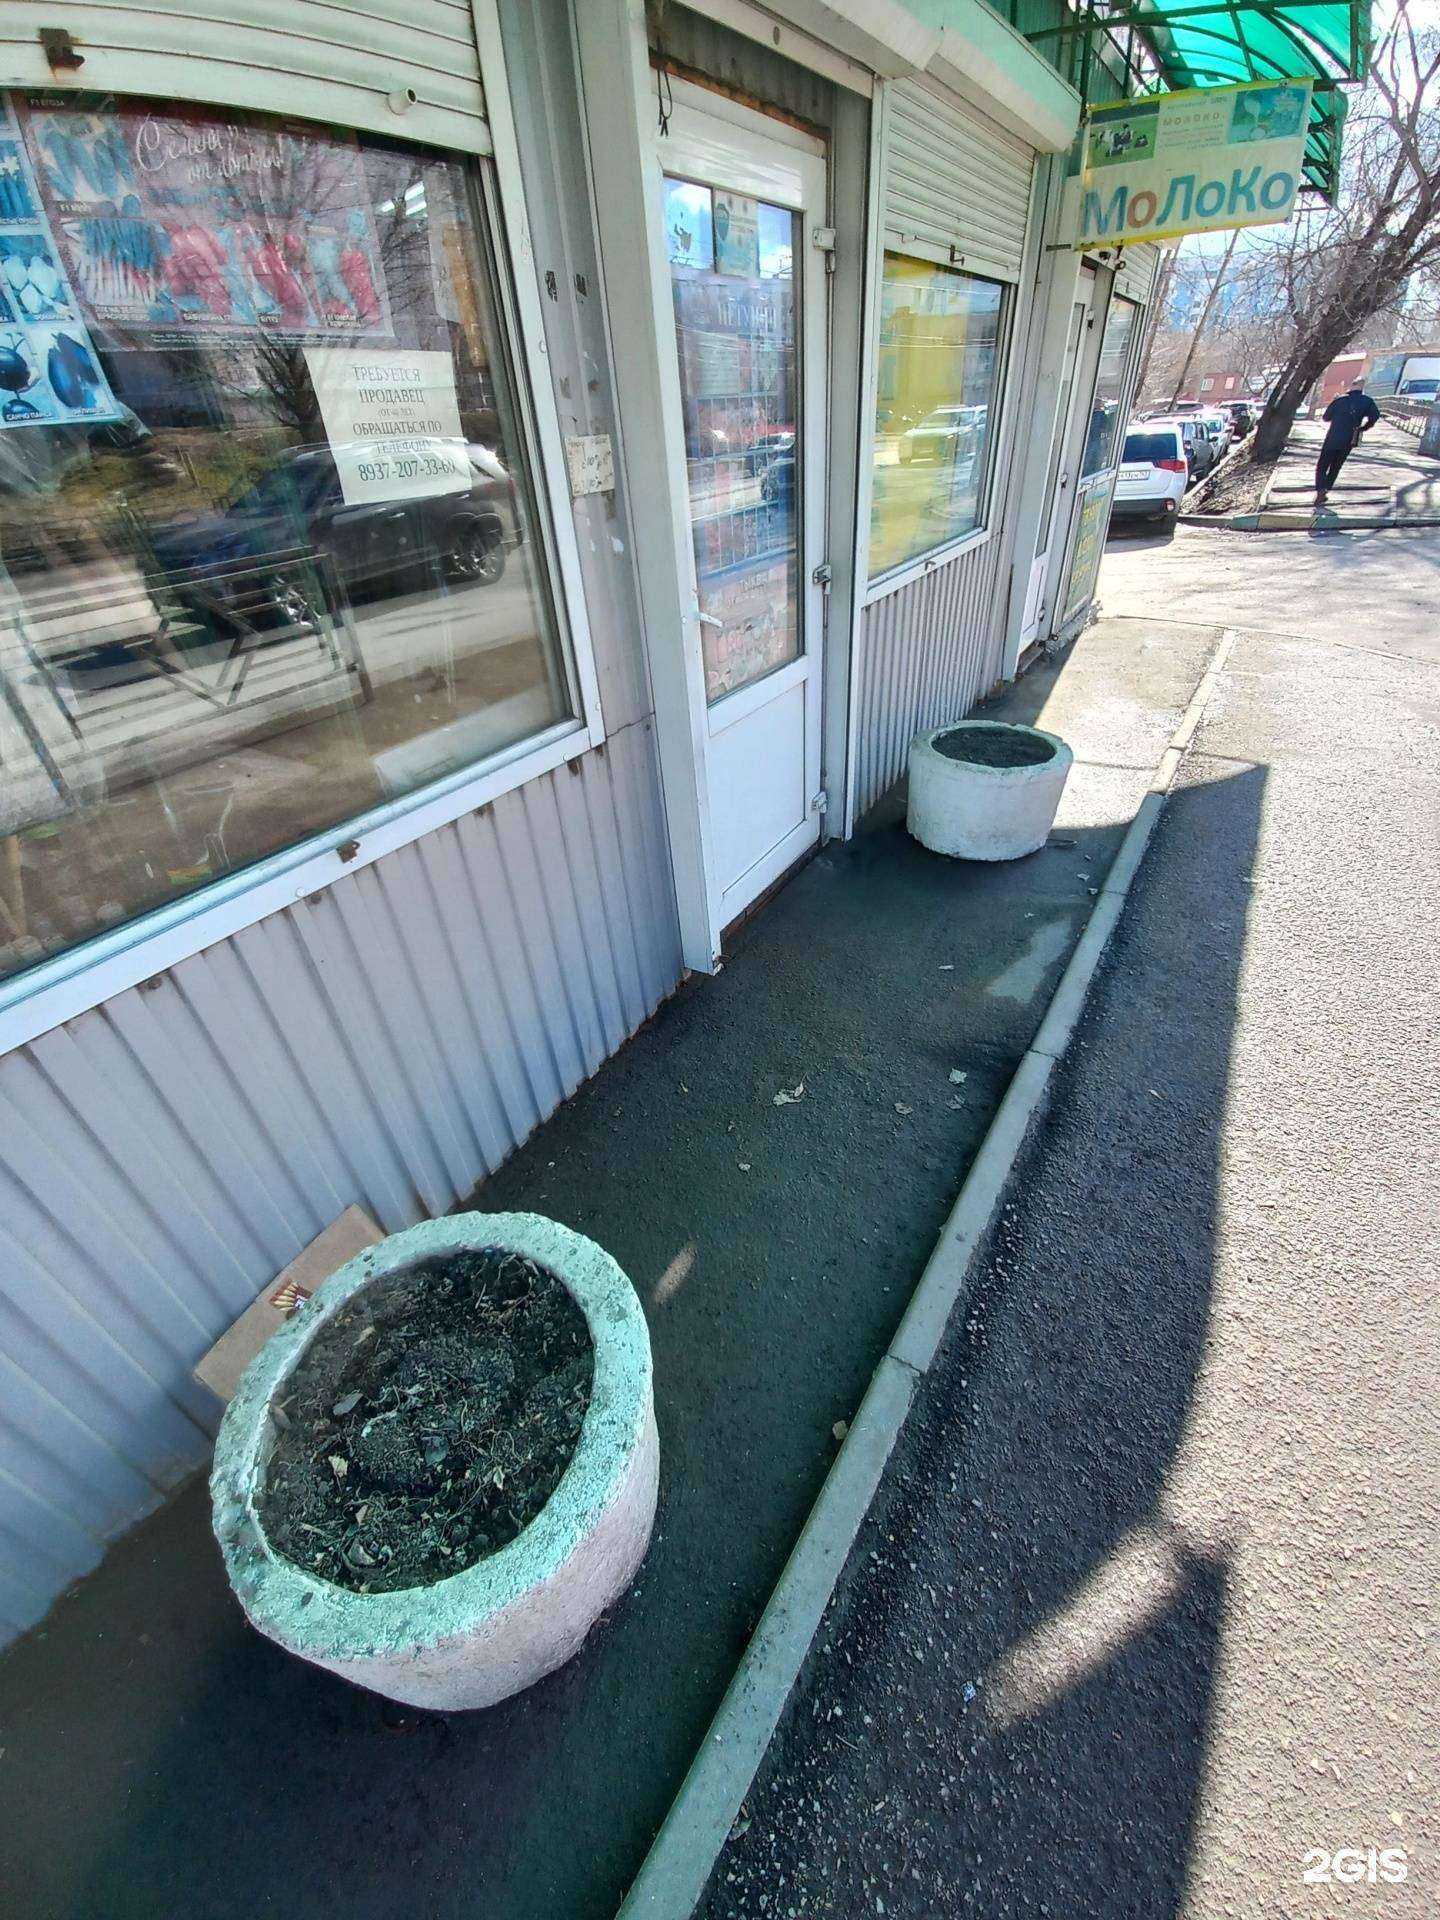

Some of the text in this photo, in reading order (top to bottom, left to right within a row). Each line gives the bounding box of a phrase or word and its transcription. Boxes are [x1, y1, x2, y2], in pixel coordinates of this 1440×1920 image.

[353, 366, 421, 382] ТРЕБУЕТСЯ
[359, 388, 425, 404] ПРОДАВЕЦ
[352, 420, 442, 436] ОБРАЩАТЬСЯ ПО
